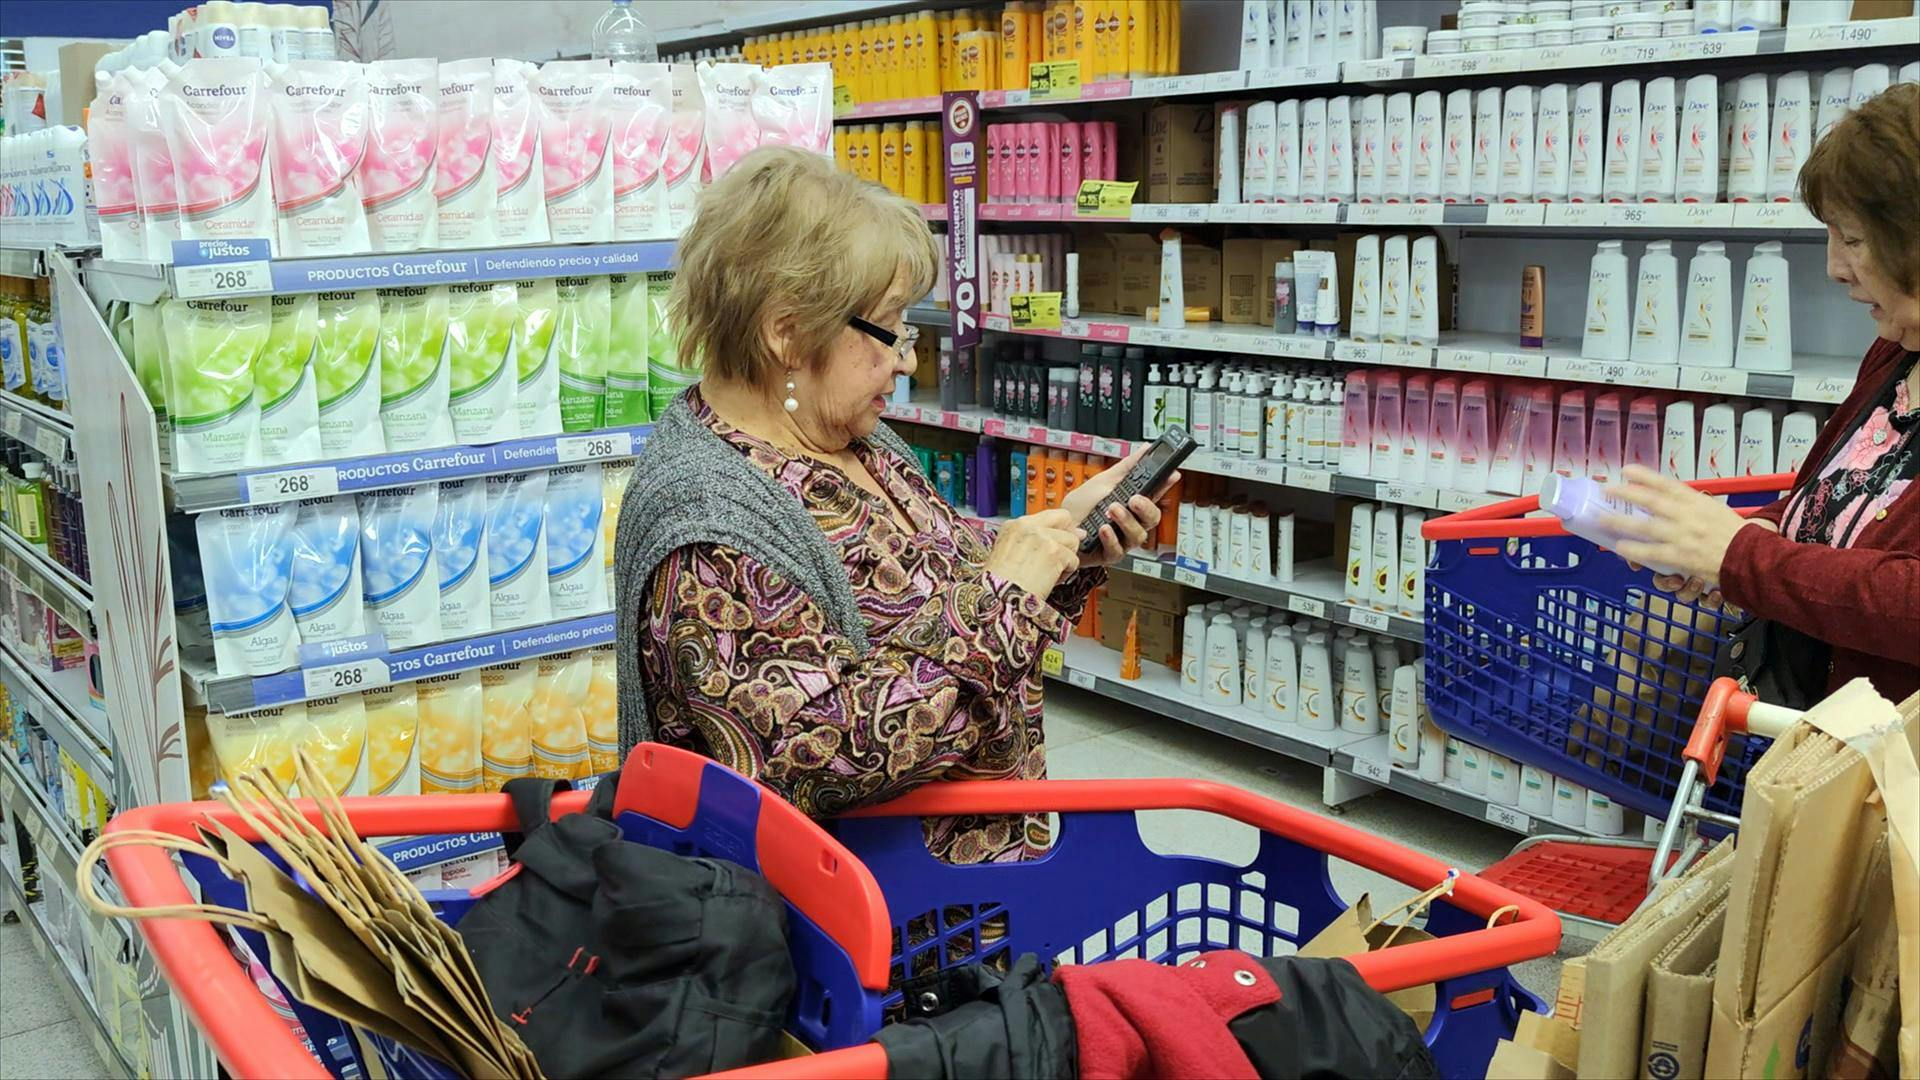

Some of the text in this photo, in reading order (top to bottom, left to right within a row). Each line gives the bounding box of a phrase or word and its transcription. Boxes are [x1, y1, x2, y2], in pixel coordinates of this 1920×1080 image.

[1840, 28, 1871, 40] 1.490
[1636, 48, 1654, 59] 719
[1702, 44, 1722, 55] 639
[183, 84, 247, 97] Carrefour
[285, 85, 347, 97] Carrefour
[368, 84, 422, 96] arrefour
[440, 83, 475, 95] refour
[539, 85, 594, 97] Carrefour
[613, 86, 651, 97] rrefour
[1648, 103, 1668, 112] Dove
[1688, 101, 1710, 111] Dove
[1624, 210, 1642, 221] 965
[199, 240, 228, 248] precios
[208, 245, 250, 259] justos
[308, 253, 639, 281] PRODUCTOS Carrefour Defendiendo precio y calidad
[556, 276, 589, 288] refour
[648, 271, 676, 282] rrefo
[449, 282, 494, 294] rrefour
[318, 291, 356, 302] refour
[187, 300, 248, 313] Carrefour
[955, 282, 976, 336] 70
[1700, 372, 1727, 382] Dove
[1815, 380, 1845, 392] Dove
[518, 401, 536, 409] zana
[453, 406, 494, 416] Manzana
[261, 426, 288, 434] nzana
[1706, 426, 1727, 435] Dove
[1743, 437, 1763, 446] Dove
[1786, 436, 1809, 444] Dove
[415, 452, 485, 472] Carrefour
[504, 446, 557, 460] Defendien
[602, 460, 635, 469] rrefou
[550, 464, 586, 476] rrefour
[487, 473, 527, 483] rrefour
[299, 496, 334, 507] refour
[559, 583, 584, 593] Algas
[494, 593, 520, 602] Algas
[380, 611, 405, 621] Algas
[309, 623, 336, 633] Algas
[251, 636, 278, 647] Algas
[424, 643, 495, 666] Carrefour
[513, 631, 580, 650] Defendiendo
[583, 624, 614, 639] precio
[331, 640, 368, 657] justos
[306, 696, 339, 708] efour
[393, 836, 467, 862] PRODUCTOS
